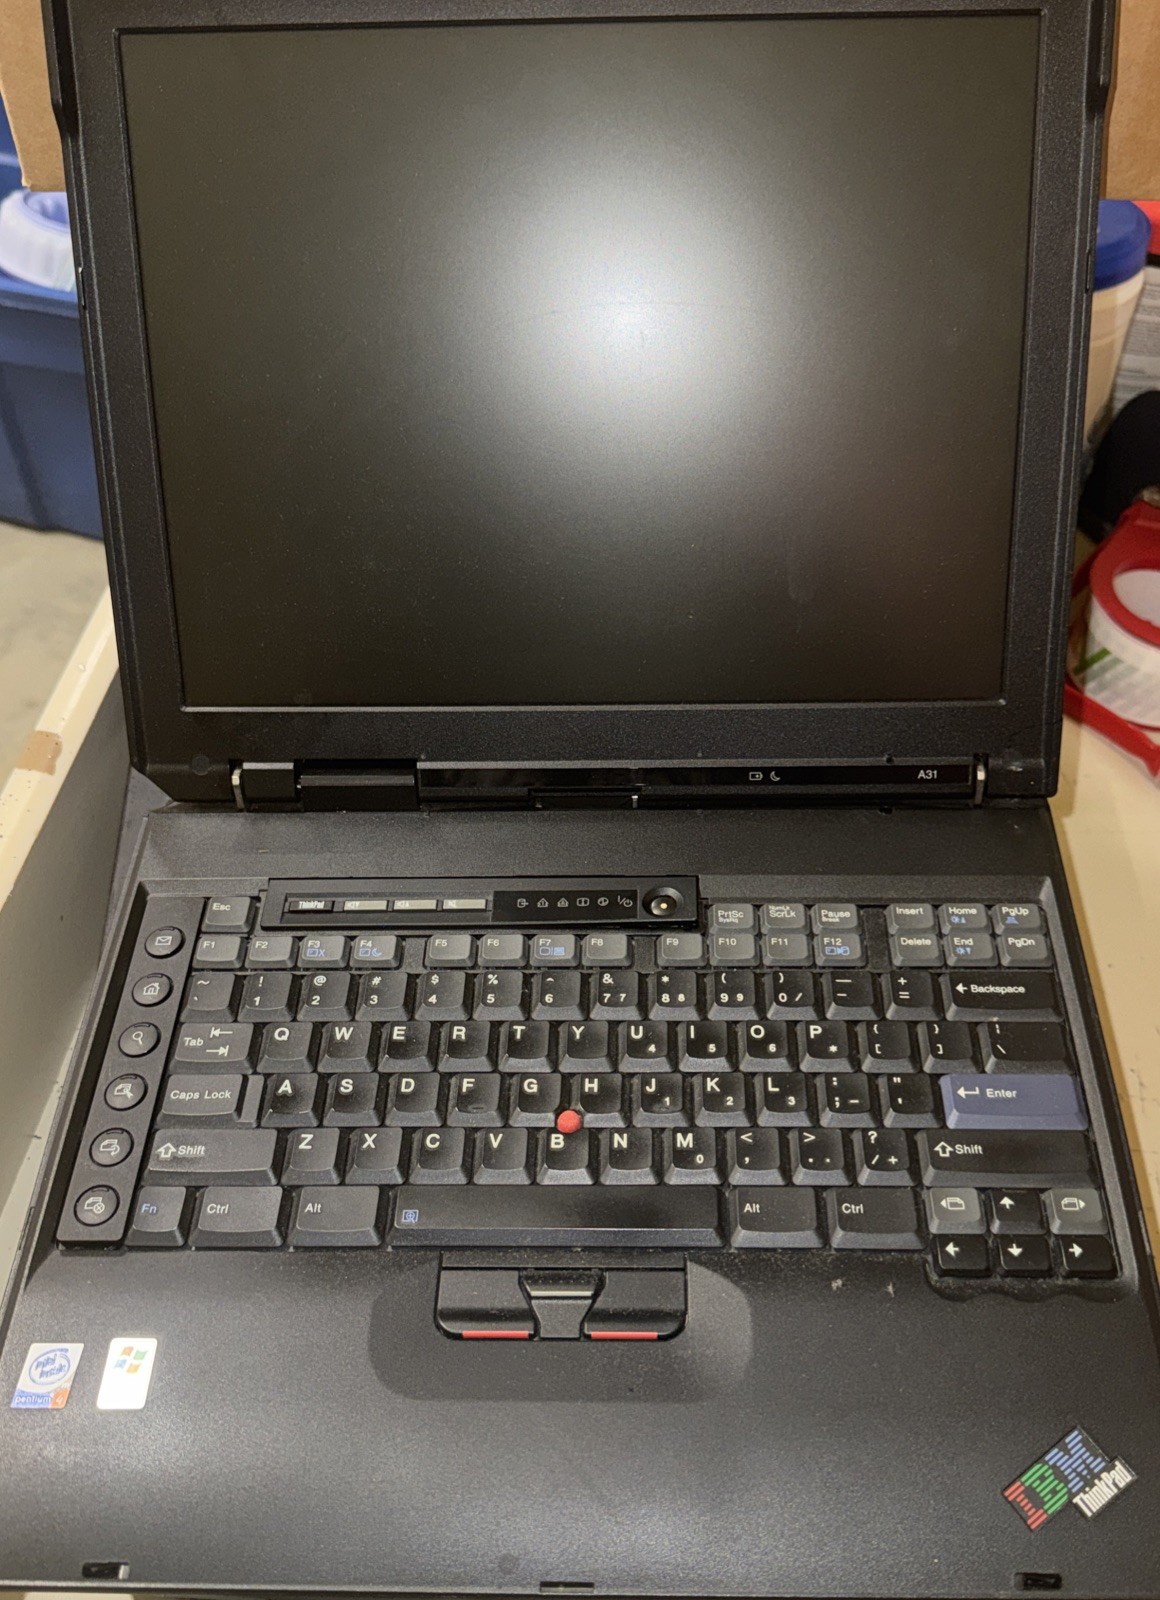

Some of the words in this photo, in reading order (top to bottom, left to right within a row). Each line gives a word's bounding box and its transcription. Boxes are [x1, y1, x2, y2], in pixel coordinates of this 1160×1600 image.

[918, 769, 938, 780] A31
[212, 902, 231, 911] Esc
[299, 900, 325, 909] ThinkPad
[718, 910, 744, 918] PrtSc
[769, 910, 796, 918] ScrLk
[821, 910, 851, 918] Pause
[896, 907, 924, 915] Insert
[949, 907, 977, 915] Home
[1002, 906, 1029, 917] PgUp
[203, 941, 215, 949] F1
[255, 941, 268, 949] F2
[308, 940, 320, 948] F3
[360, 939, 372, 948] F4
[435, 939, 447, 947] F5
[540, 938, 551, 946] F7
[591, 938, 604, 946] F8
[667, 938, 679, 946] F9
[718, 938, 737, 946] F10
[771, 938, 789, 946] F11
[900, 937, 931, 946] Delete
[954, 937, 974, 946] End
[1008, 937, 1035, 947] PgDn
[313, 975, 327, 986] @
[371, 976, 382, 986] #
[431, 974, 440, 985] $
[488, 974, 498, 985] %
[602, 973, 614, 984] &
[970, 984, 1025, 994] Backspace
[254, 997, 261, 1006] 1
[311, 996, 320, 1005] 2
[370, 995, 378, 1005] 3
[428, 994, 437, 1004] 4
[487, 994, 495, 1004] 5
[545, 994, 554, 1004] 6
[603, 994, 611, 1003] 7
[619, 993, 627, 1002] 7
[661, 993, 670, 1003] 8
[678, 993, 686, 1002] 8
[720, 993, 729, 1003] 9
[736, 993, 744, 1002] 9
[274, 1027, 290, 1041] Q
[335, 1027, 354, 1040] W
[393, 1026, 406, 1040] E
[452, 1026, 466, 1039] R
[513, 1026, 526, 1039] T
[572, 1026, 585, 1039] Y
[631, 1025, 644, 1039] U
[750, 1025, 765, 1039] O
[809, 1025, 822, 1039] P
[184, 1038, 203, 1047] Tab
[648, 1044, 656, 1053] 4
[708, 1044, 716, 1053] 5
[769, 1044, 777, 1053] 6
[278, 1079, 293, 1094] A
[340, 1079, 354, 1093] S
[401, 1078, 415, 1092] D
[462, 1078, 475, 1092] F
[523, 1078, 538, 1093] G
[584, 1078, 599, 1092] H
[645, 1078, 656, 1092] J
[707, 1077, 721, 1092] K
[768, 1077, 780, 1092] L
[170, 1090, 200, 1101] Caps
[204, 1090, 231, 1099] Lock
[986, 1088, 1017, 1098] Enter
[664, 1097, 670, 1106] 1
[726, 1096, 734, 1106] 2
[788, 1096, 796, 1105] 3
[299, 1134, 314, 1149] Z
[362, 1134, 378, 1148] X
[426, 1134, 440, 1148] C
[490, 1134, 503, 1148] V
[550, 1134, 565, 1148] B
[613, 1133, 628, 1148] N
[676, 1133, 693, 1148] M
[868, 1131, 878, 1143] ?
[178, 1145, 206, 1155] Shift
[955, 1144, 983, 1155] Shift
[140, 1203, 157, 1214] Fn
[207, 1203, 229, 1214] Ctrl
[304, 1203, 322, 1214] Alt
[743, 1203, 761, 1214] Alt
[842, 1203, 864, 1214] Ctrl
[15, 1395, 51, 1405] pentium
[1003, 1430, 1106, 1530] IBM
[1072, 1460, 1133, 1517] ThinkPad
